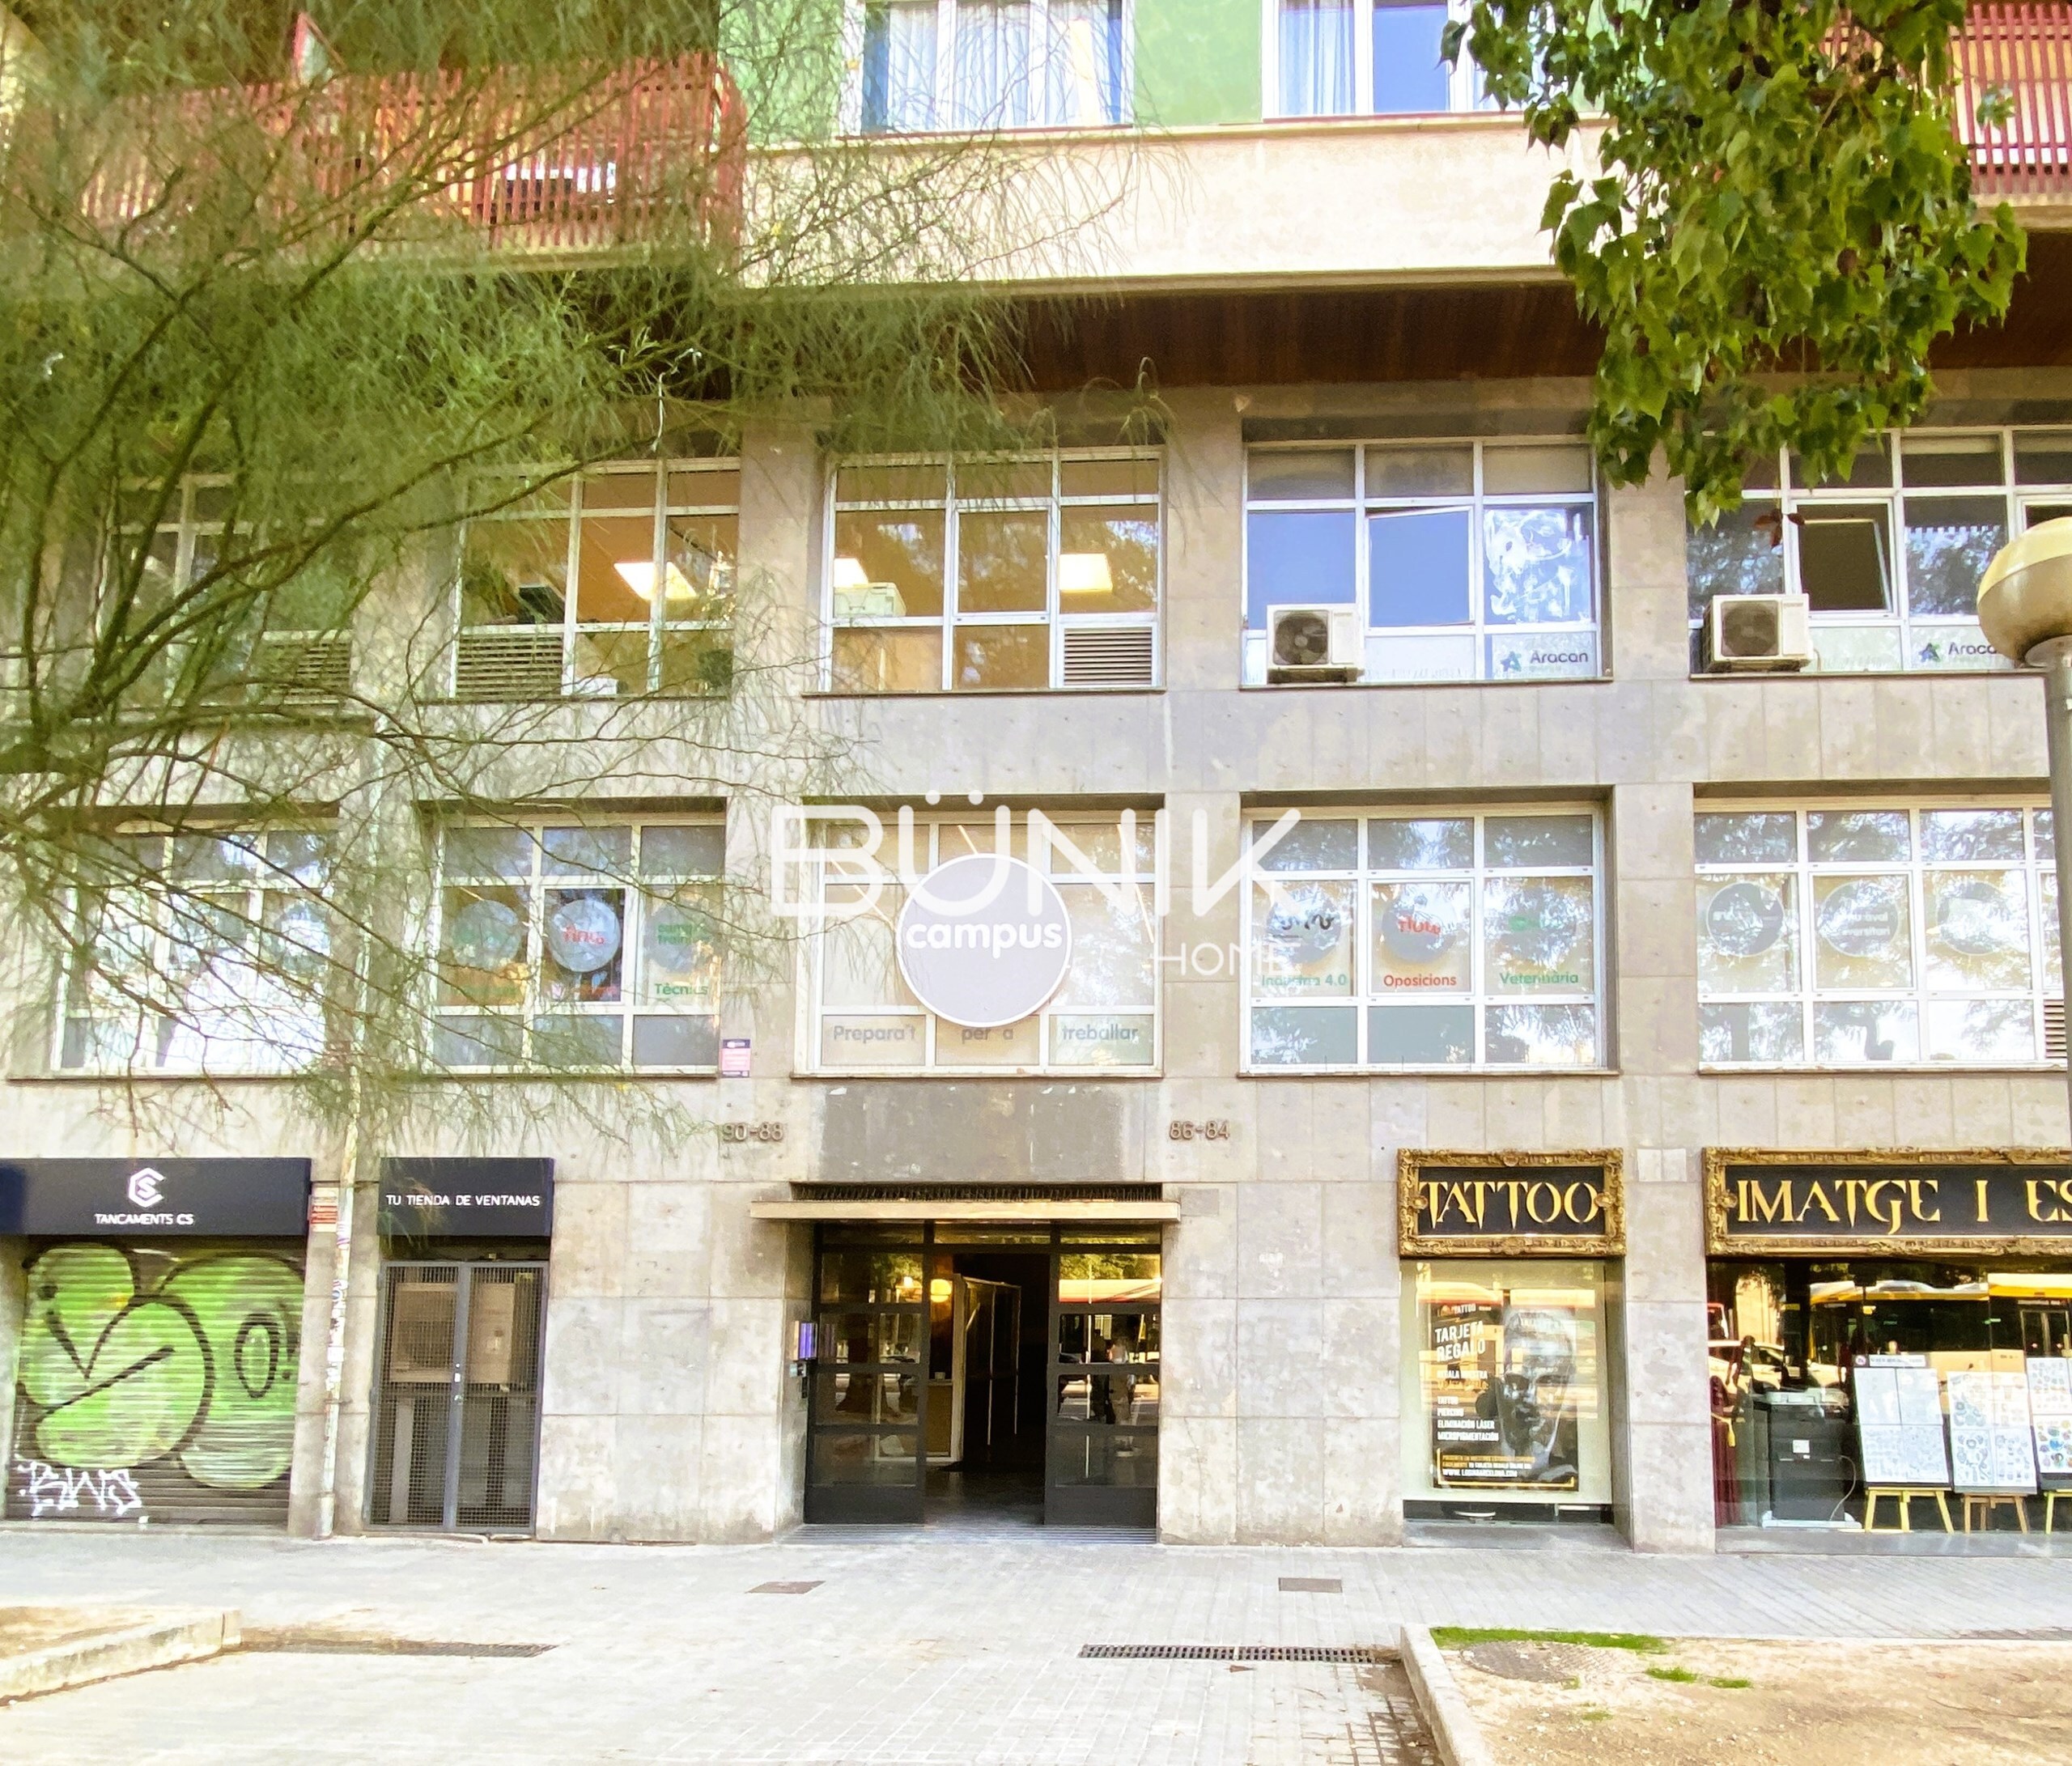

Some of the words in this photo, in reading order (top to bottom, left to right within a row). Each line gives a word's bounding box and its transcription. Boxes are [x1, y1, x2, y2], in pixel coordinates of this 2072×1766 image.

[1529, 650, 1589, 664] Aracan
[1947, 641, 1998, 655] Araca
[906, 920, 1063, 959] campus
[1383, 974, 1458, 988] Oposicions
[962, 1027, 990, 1042] per
[1003, 1028, 1014, 1041] a
[1062, 1024, 1140, 1042] treballar
[722, 1122, 784, 1142] 90-88
[1169, 1120, 1231, 1141] 86-84
[386, 1195, 402, 1206] TU
[406, 1195, 450, 1206] TIENDA
[456, 1195, 473, 1206] DE
[475, 1195, 541, 1207] VENTANAS
[1419, 1181, 1599, 1230] TATTOO
[1736, 1179, 1941, 1235] IMATGE
[1975, 1179, 1989, 1222] I
[95, 1213, 174, 1225] TANCAMENTS
[176, 1213, 195, 1225] CS
[1435, 1320, 1484, 1344] TARJETA
[1437, 1338, 1486, 1362] REGALO
